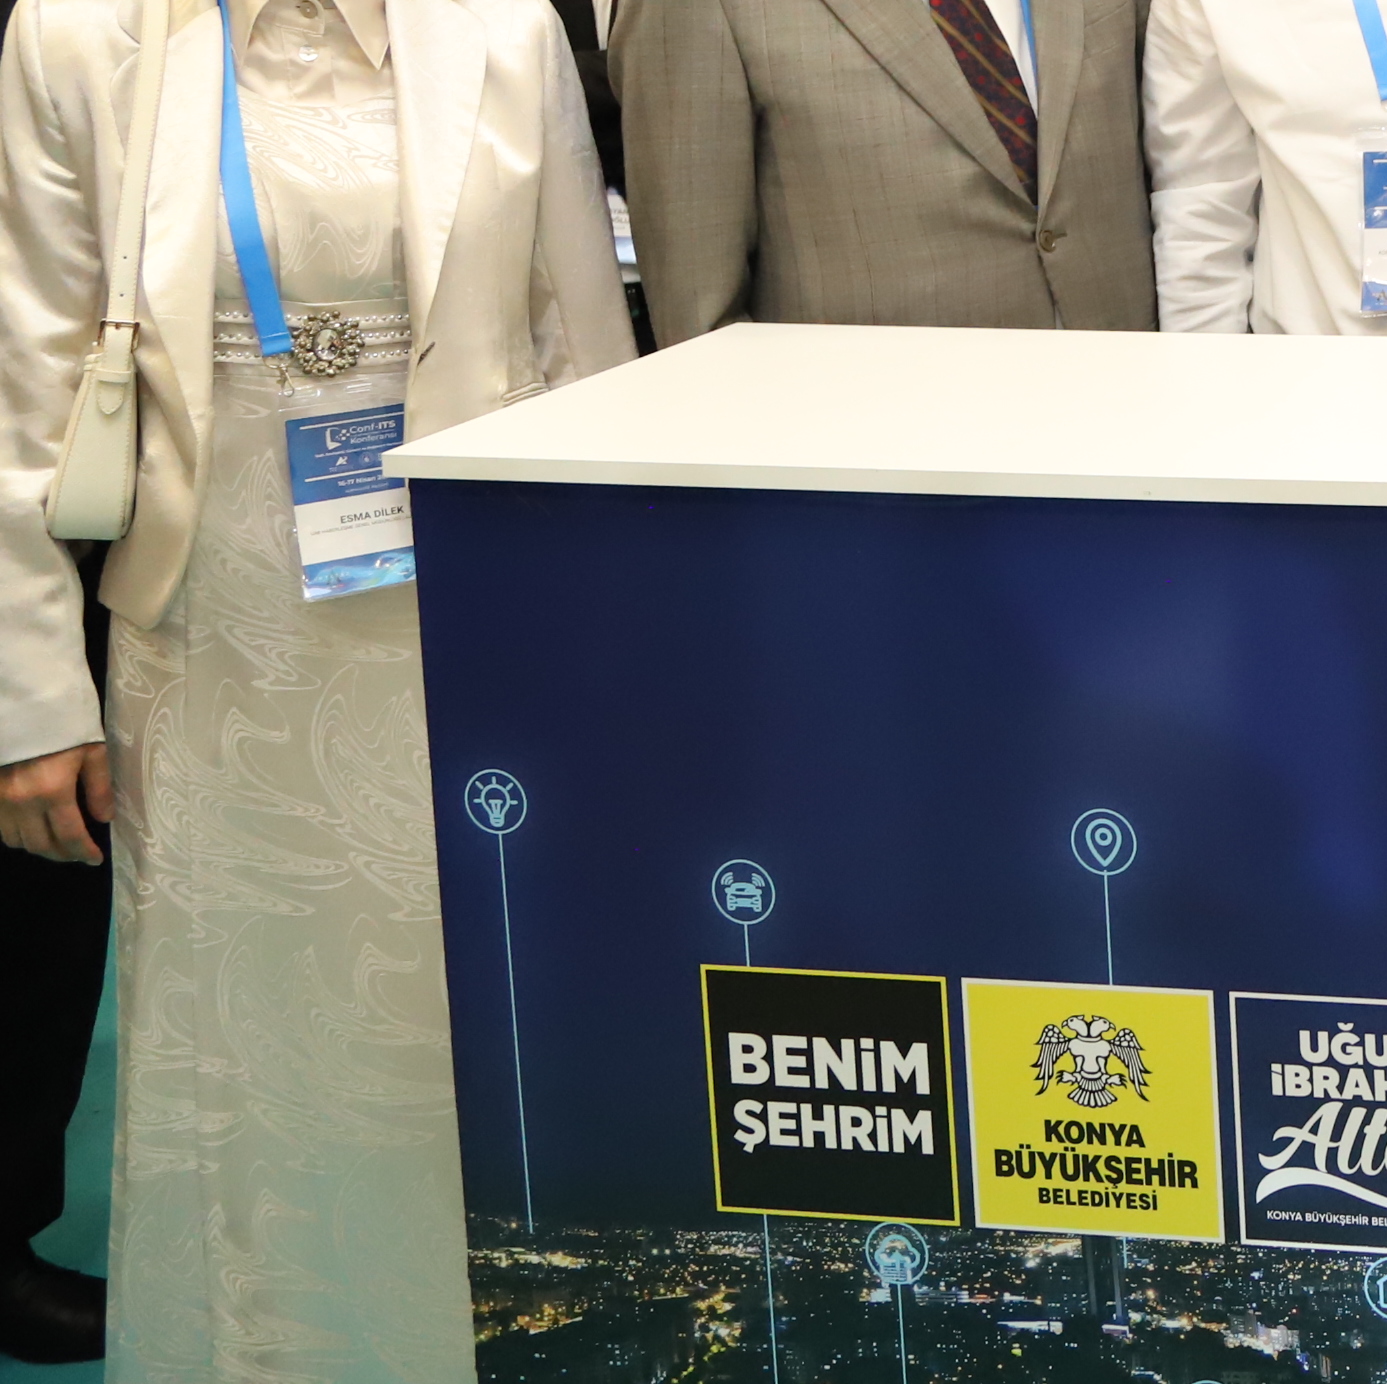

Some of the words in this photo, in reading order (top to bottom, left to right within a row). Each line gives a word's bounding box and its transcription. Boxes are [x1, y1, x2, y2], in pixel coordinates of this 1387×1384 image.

[349, 420, 396, 434] Conf-ITS
[340, 512, 372, 524] ESMA
[373, 505, 404, 518] DİLEK
[1044, 1119, 1146, 1148] KONYA
[994, 1144, 1199, 1189] BÜYÜKŞEHİR
[1038, 1187, 1158, 1211] BELEDİYESİ
[1266, 1210, 1303, 1222] KONYA
[1305, 1211, 1369, 1227] BÜYÜKŞEHİR
